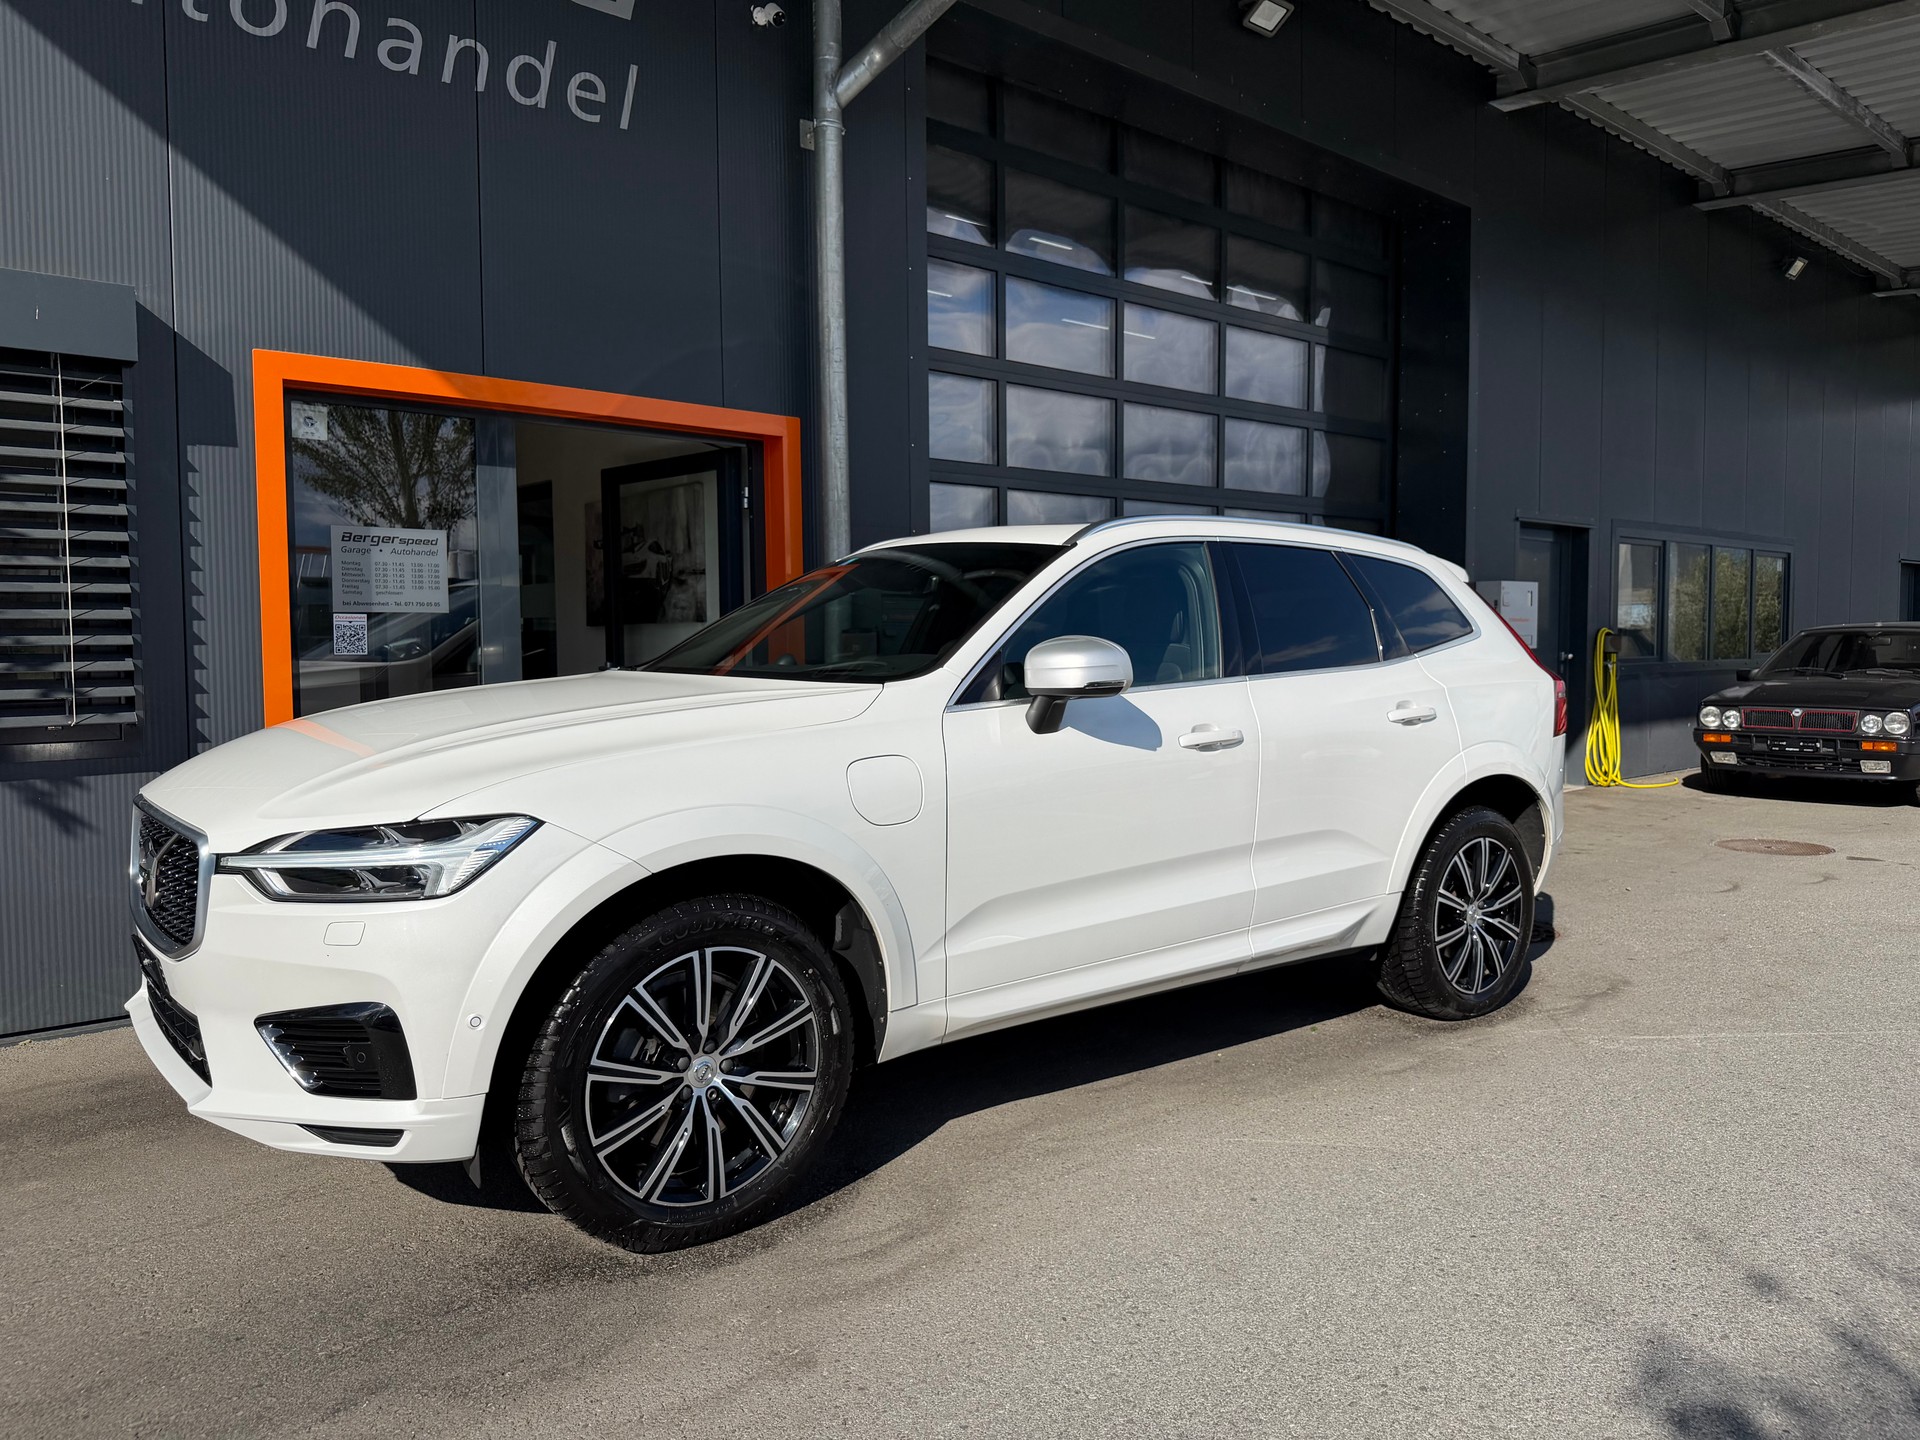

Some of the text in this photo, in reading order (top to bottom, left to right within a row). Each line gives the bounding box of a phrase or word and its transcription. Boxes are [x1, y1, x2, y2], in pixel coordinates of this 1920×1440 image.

[341, 532, 438, 546] Bergerspeed
[341, 546, 438, 556] Garage Autohandel
